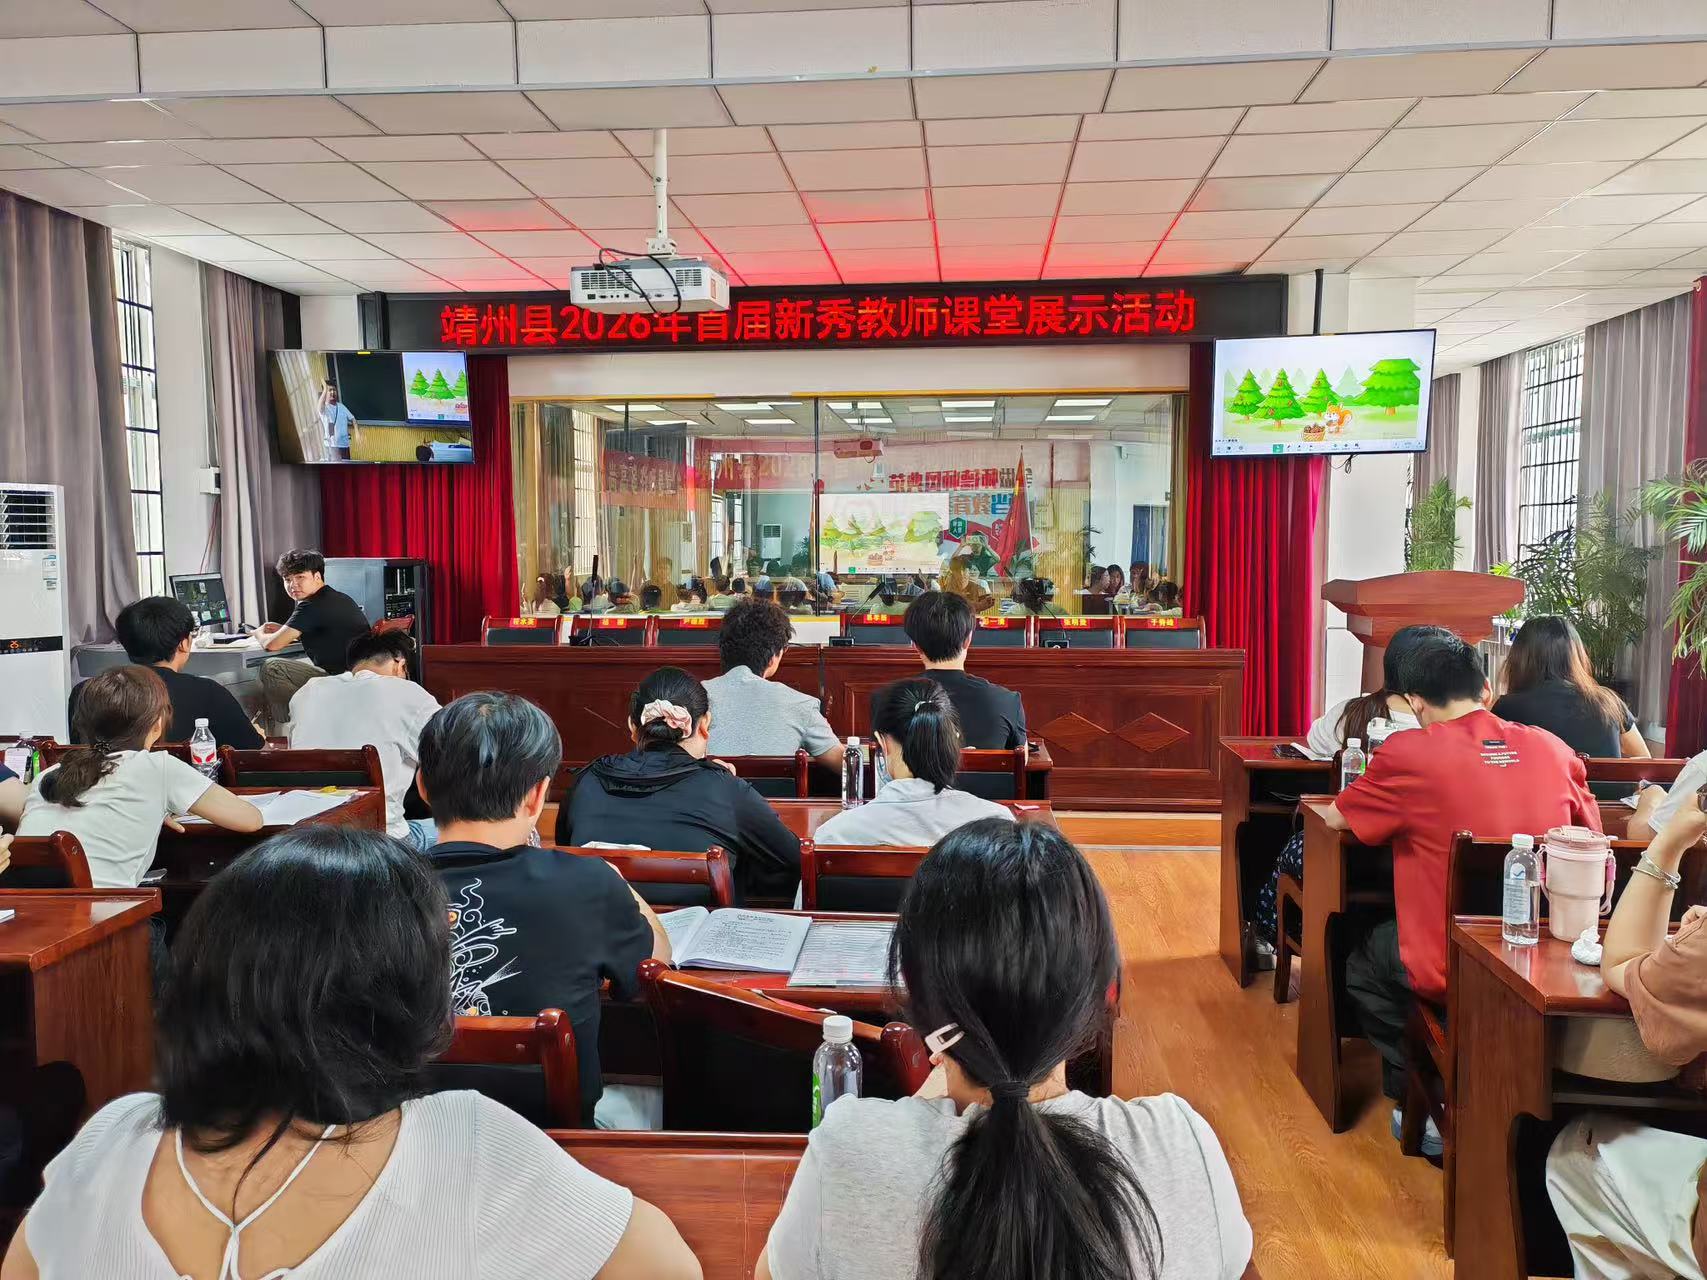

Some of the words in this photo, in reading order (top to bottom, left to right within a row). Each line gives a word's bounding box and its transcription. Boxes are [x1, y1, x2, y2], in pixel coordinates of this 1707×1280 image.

[440, 290, 1195, 344] 靖州县2026年首届新秀教师课堂展示活动
